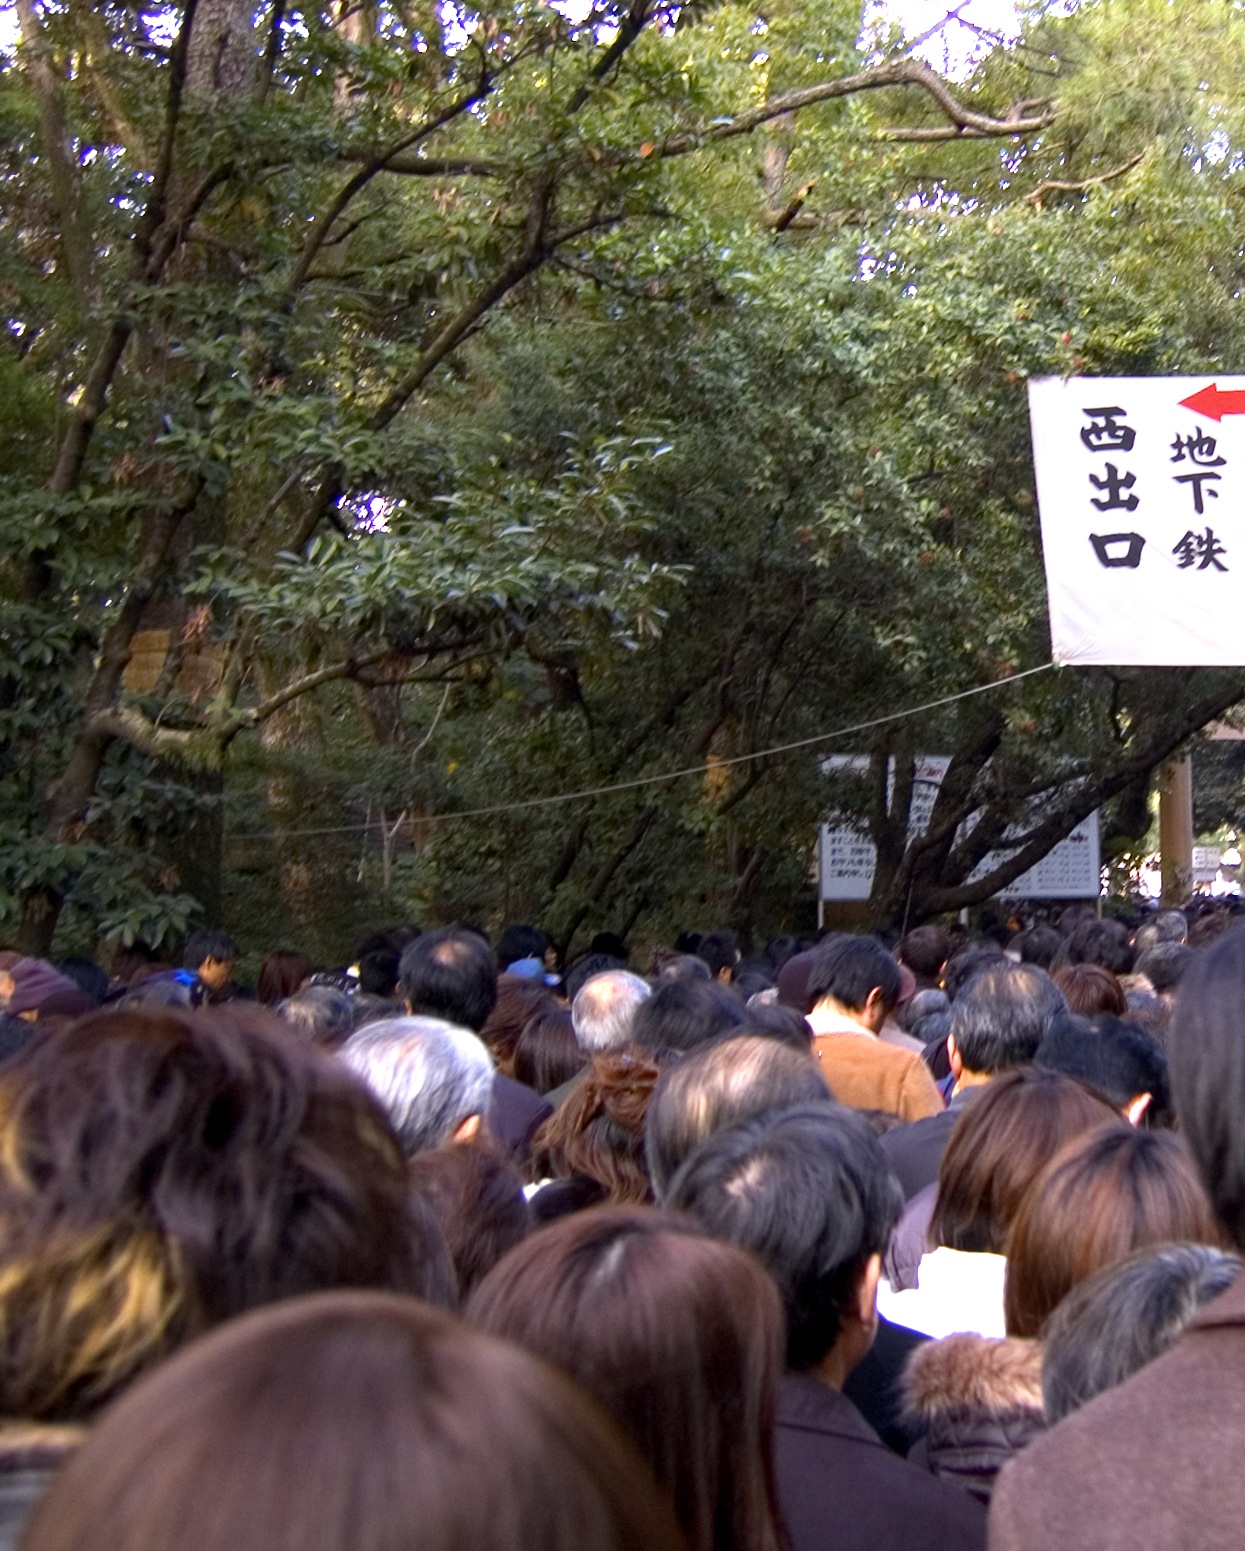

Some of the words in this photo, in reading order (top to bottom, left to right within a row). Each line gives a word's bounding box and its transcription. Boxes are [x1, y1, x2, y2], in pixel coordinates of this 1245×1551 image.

[1080, 406, 1146, 568] 西出口
[1170, 426, 1229, 572] 地下鉄
